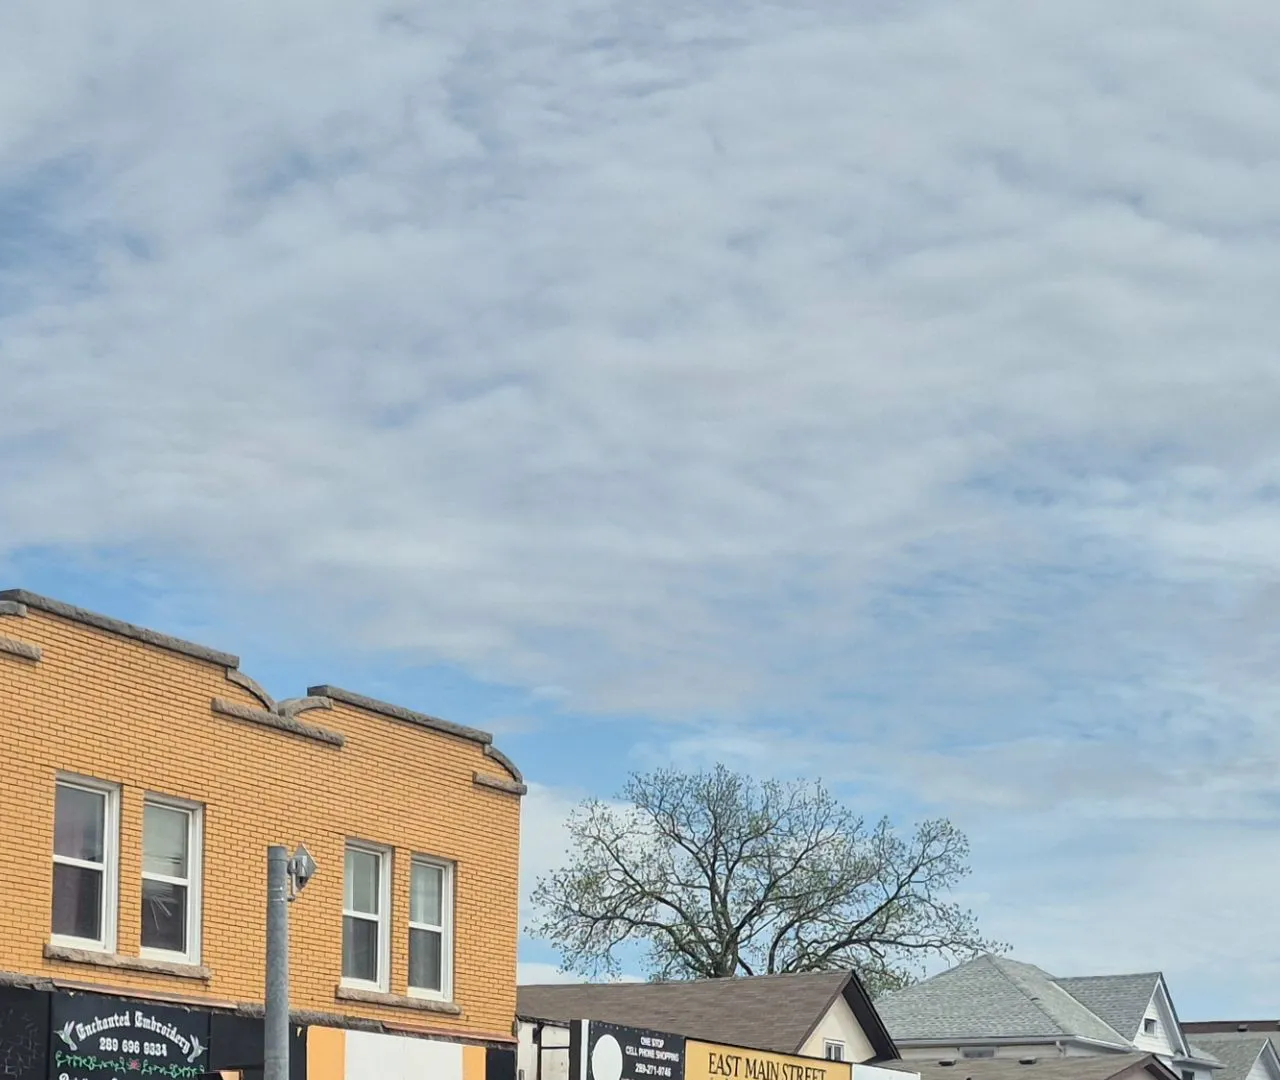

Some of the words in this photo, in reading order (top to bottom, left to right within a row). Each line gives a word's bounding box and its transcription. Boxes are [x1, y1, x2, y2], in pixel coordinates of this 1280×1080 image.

[75, 1010, 131, 1042] Enchanted
[134, 1010, 192, 1055] Embroidery
[98, 1037, 118, 1052] 289
[122, 1039, 140, 1055] 696
[708, 1052, 742, 1077] EAST
